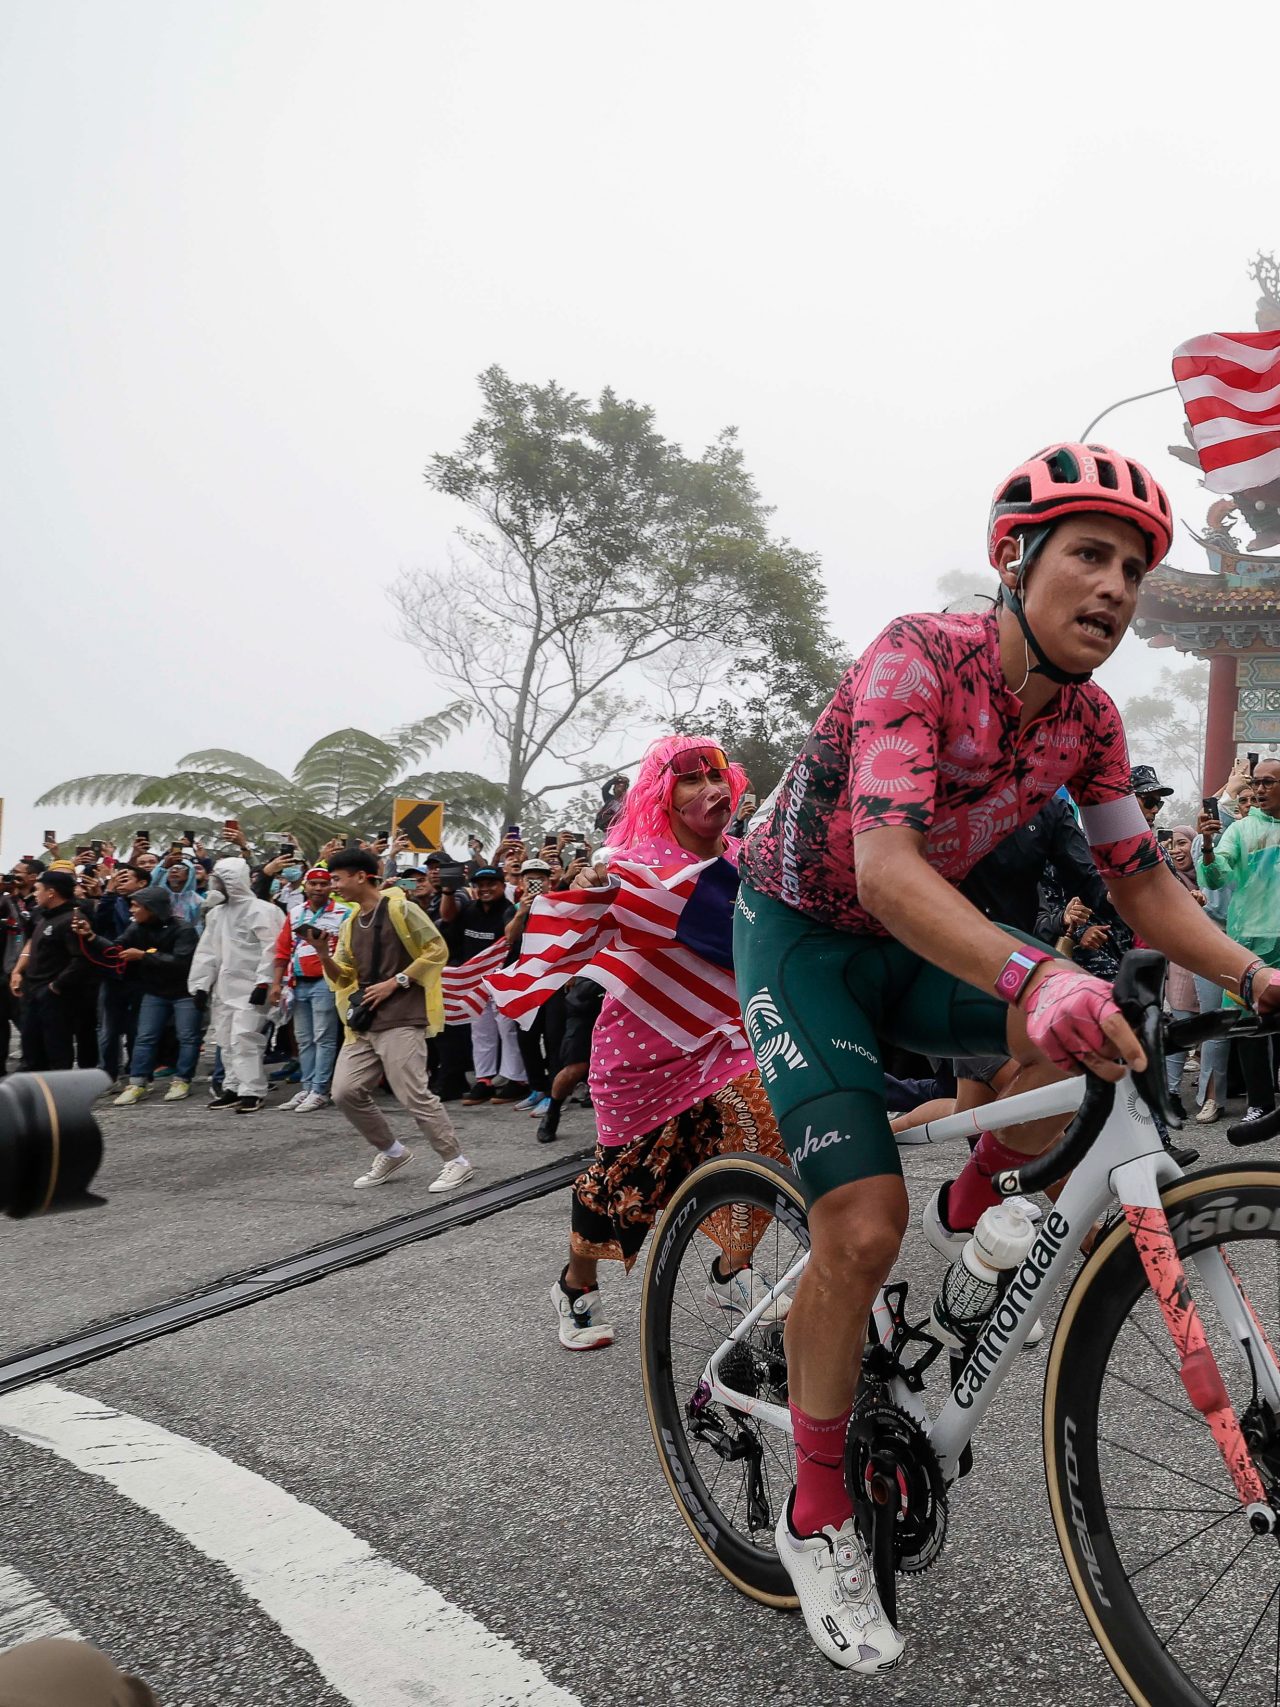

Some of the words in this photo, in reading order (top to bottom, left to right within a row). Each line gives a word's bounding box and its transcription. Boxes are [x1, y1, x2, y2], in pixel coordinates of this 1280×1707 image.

[780, 763, 810, 906] cannondale
[831, 1038, 878, 1064] WHOOP
[655, 1197, 697, 1287] metron
[954, 1211, 1070, 1410] cannondale
[864, 1409, 877, 1419] FULL
[878, 1407, 897, 1417] SPEED
[1064, 1415, 1112, 1608] metron
